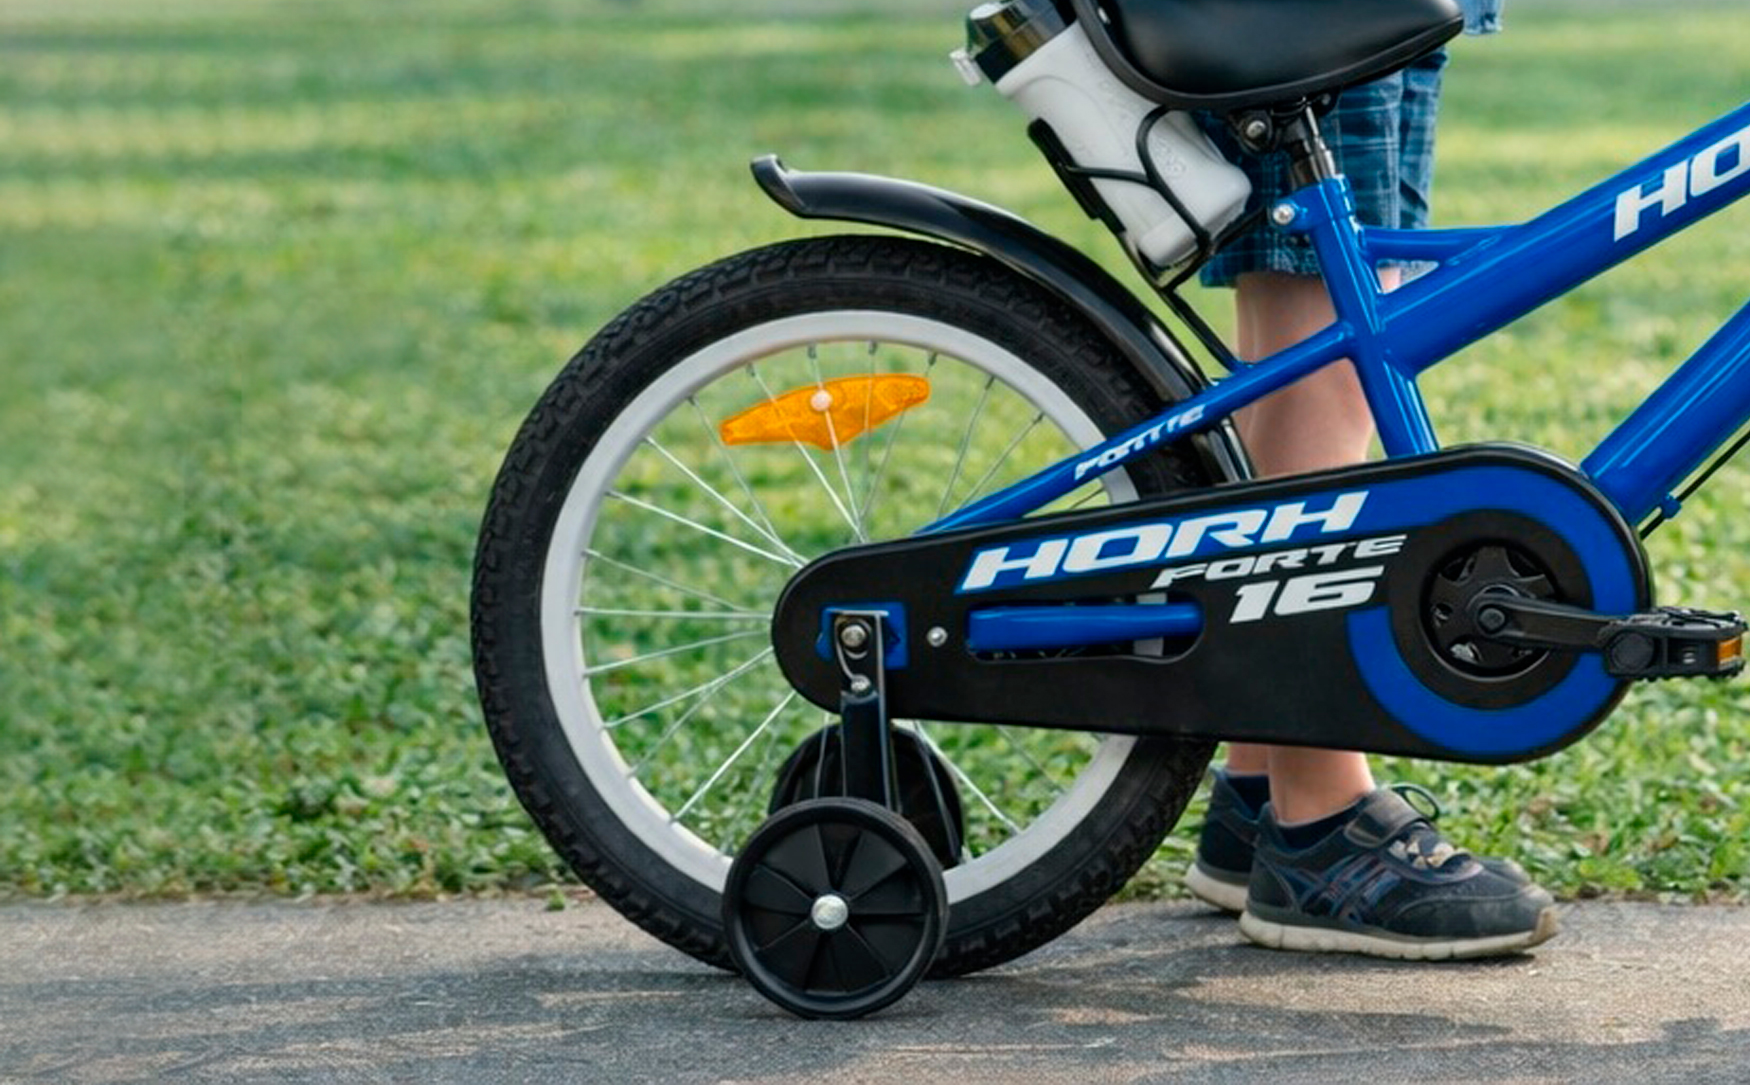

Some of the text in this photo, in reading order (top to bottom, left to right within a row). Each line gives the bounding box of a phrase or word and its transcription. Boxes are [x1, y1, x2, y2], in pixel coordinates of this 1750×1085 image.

[963, 491, 1369, 590] HORH
[1150, 534, 1407, 589] FORTE
[1230, 565, 1385, 623] 16
